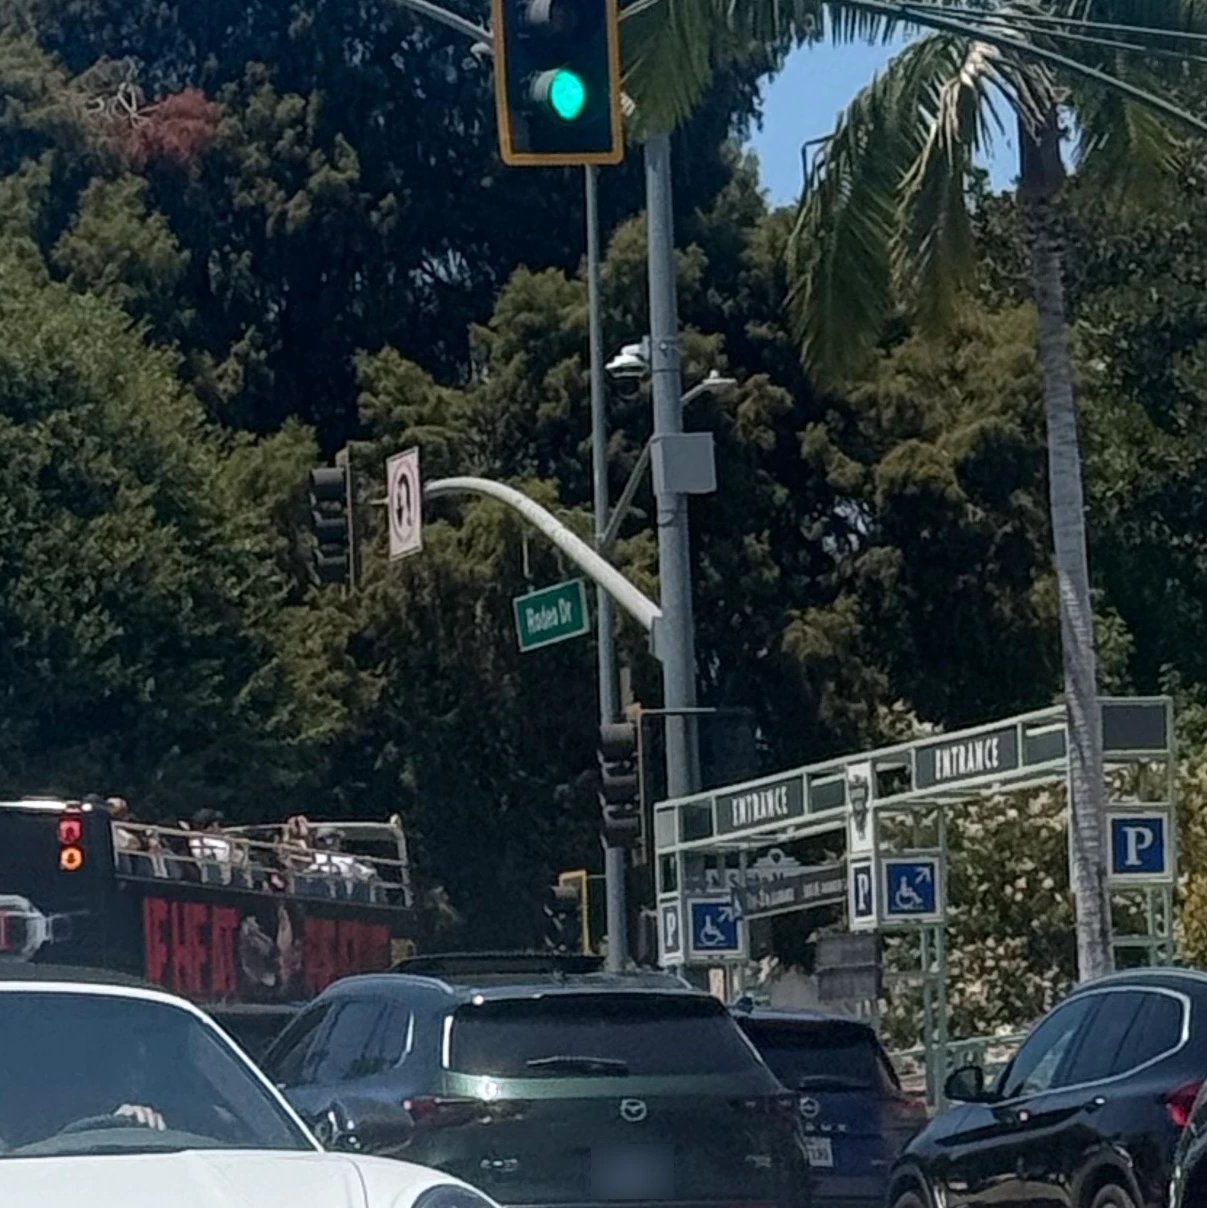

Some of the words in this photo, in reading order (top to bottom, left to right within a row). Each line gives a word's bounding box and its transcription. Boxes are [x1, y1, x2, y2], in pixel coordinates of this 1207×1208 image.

[526, 602, 559, 636] Rodeo
[558, 597, 572, 625] Dr
[934, 737, 999, 780] ENTRANCE
[732, 785, 788, 827] ENTRANCE
[1122, 826, 1154, 866] P
[856, 872, 869, 911] P
[666, 911, 677, 947] P
